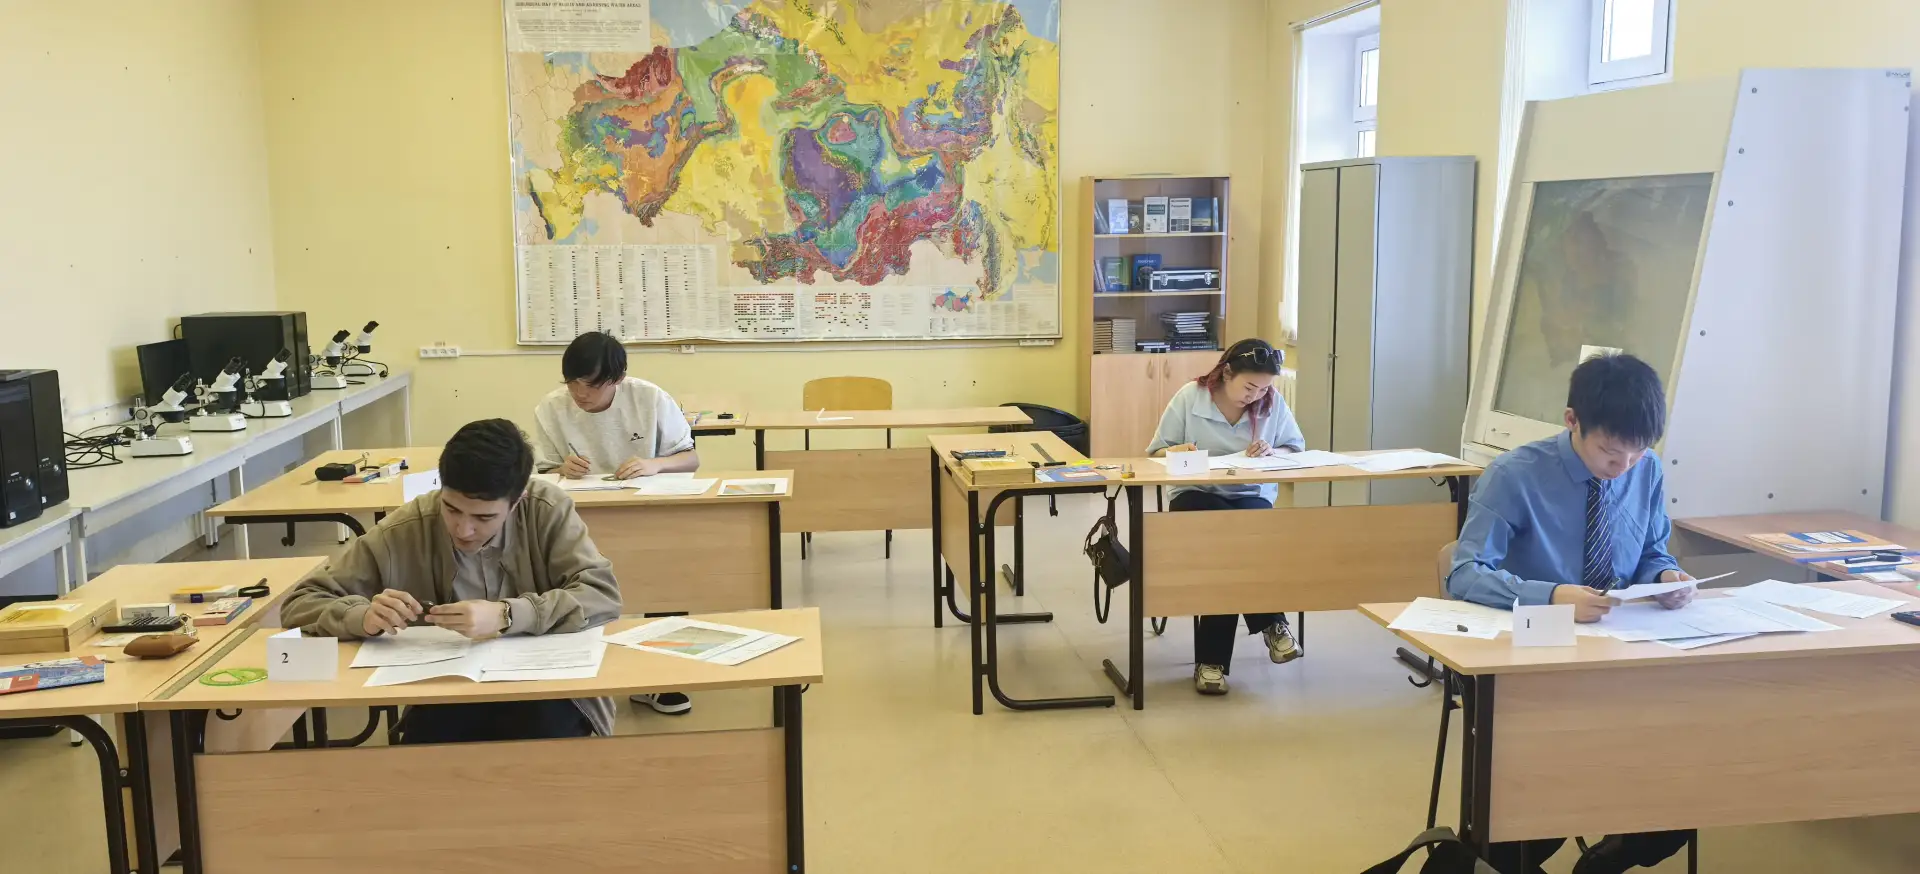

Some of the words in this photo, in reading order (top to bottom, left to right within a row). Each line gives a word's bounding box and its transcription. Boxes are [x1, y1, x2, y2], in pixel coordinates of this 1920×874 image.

[1183, 460, 1188, 468] 3
[1526, 618, 1531, 629] 1
[281, 652, 289, 664] 2
